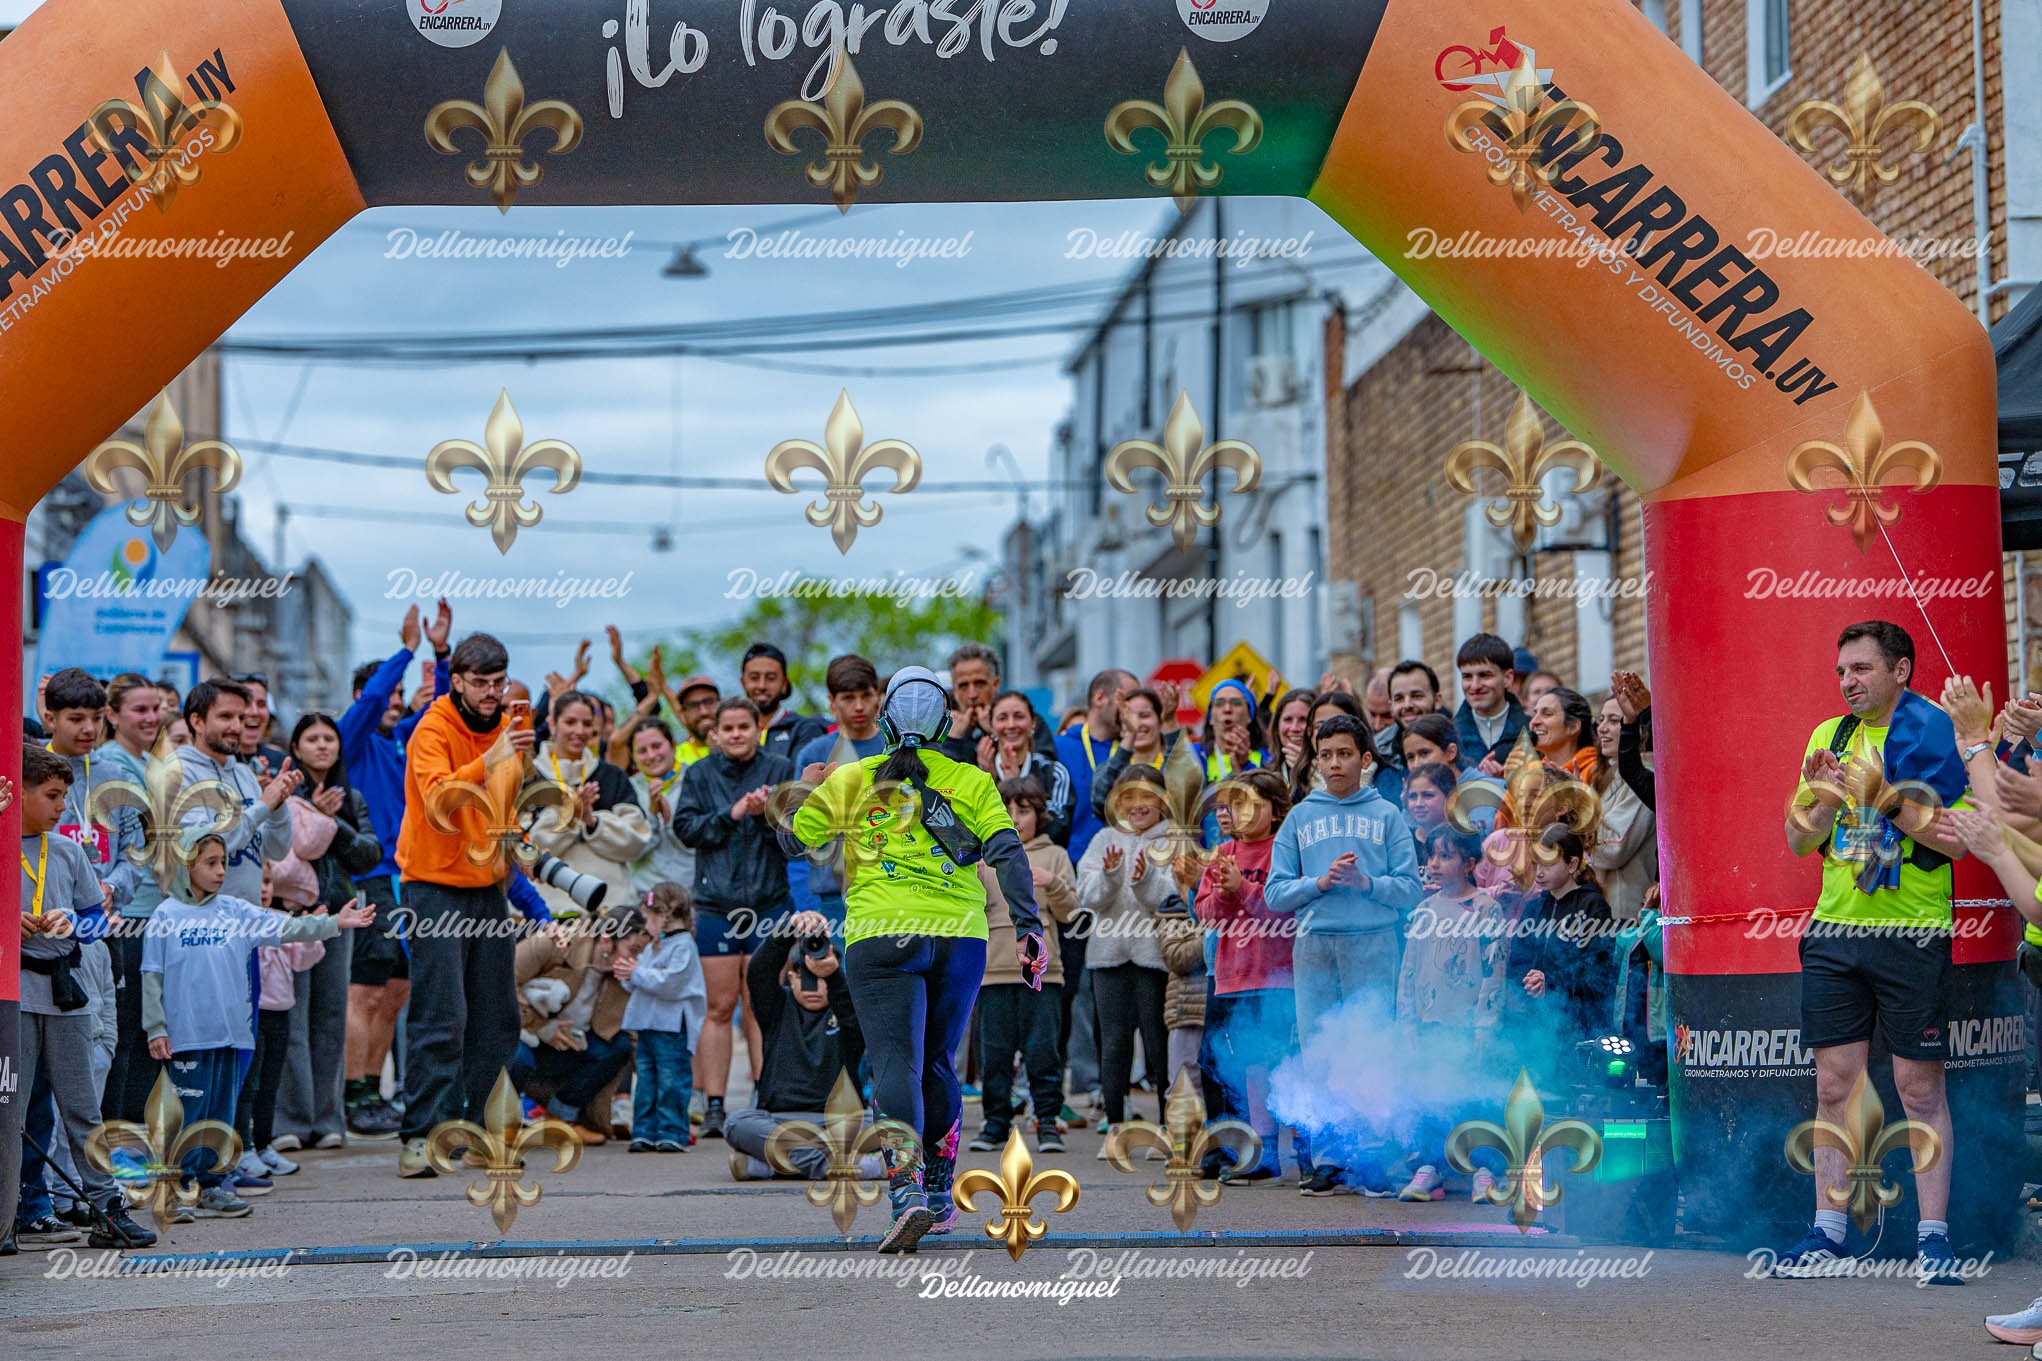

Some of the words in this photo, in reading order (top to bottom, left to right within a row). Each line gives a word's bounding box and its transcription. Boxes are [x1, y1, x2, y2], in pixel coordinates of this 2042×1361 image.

[419, 15, 492, 30] ENCARRERA.UY
[1188, 10, 1261, 25] ENCARRERA.UY
[0, 247, 86, 337] ETRAMOS
[99, 127, 215, 240] DIFUNDIMOS
[1462, 126, 1628, 275] CRONOMETRAMOS
[1625, 271, 1646, 287] Y
[1637, 280, 1757, 390] DIFUNDIMOS
[1297, 814, 1385, 849] MALIBU
[1948, 1014, 2025, 1057] NCARRE
[1685, 1068, 1749, 1078] CRONOMETRAMOS
[1750, 1069, 1759, 1078] Y
